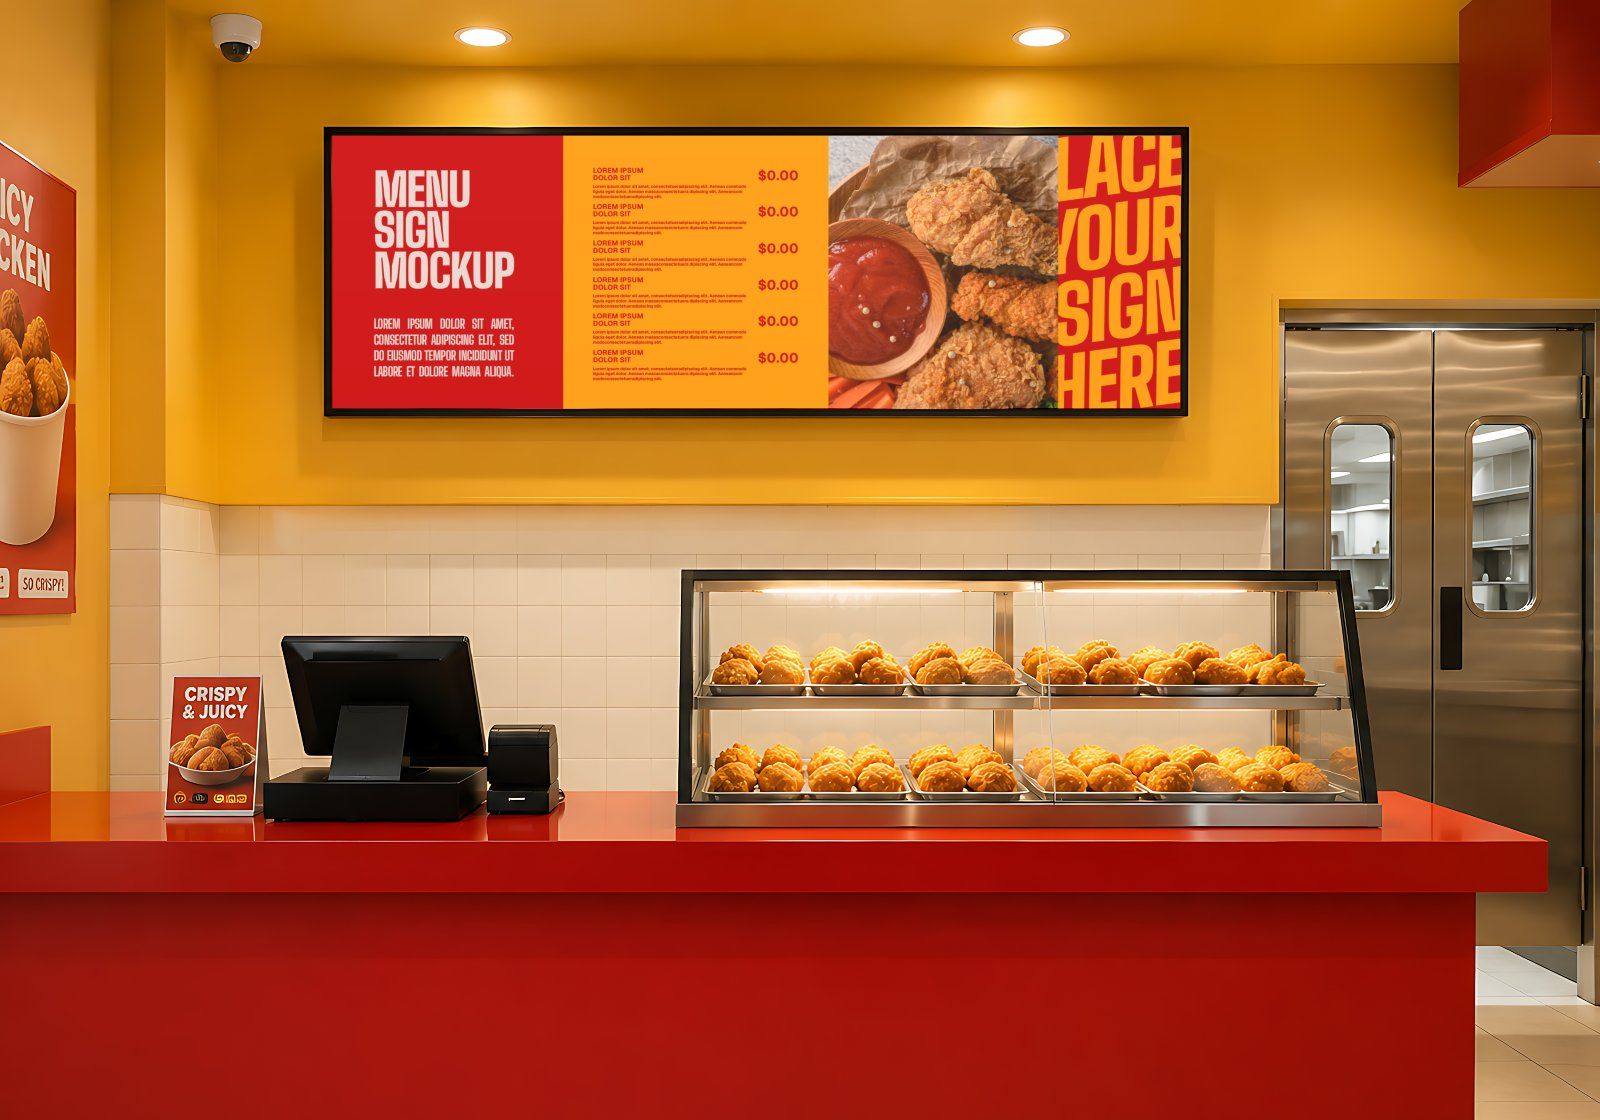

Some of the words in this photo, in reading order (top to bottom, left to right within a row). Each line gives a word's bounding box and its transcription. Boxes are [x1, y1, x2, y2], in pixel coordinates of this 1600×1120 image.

[1058, 135, 1181, 201] LACE
[759, 169, 798, 181] $0.00
[376, 170, 470, 208] MENU
[759, 205, 798, 218] $0.00
[375, 210, 449, 248] SIGN
[1058, 195, 1181, 275] YOUR
[758, 242, 798, 254] $0.00
[375, 251, 514, 289] MOCKUP
[758, 279, 798, 291] $0.00
[1058, 266, 1181, 347] SIGN
[374, 318, 400, 329] LOREM
[408, 318, 432, 329] IPSUM
[440, 318, 465, 329] DOLOR
[472, 318, 484, 329] SIT
[491, 318, 514, 330] AMET,
[759, 315, 798, 327] $0.00
[374, 334, 427, 345] CONSECTETUR
[431, 334, 474, 345] ADIPISCING
[478, 334, 495, 346] ELIT,
[500, 334, 514, 345] SED
[374, 350, 384, 361] DO
[387, 350, 422, 361] EIUSMOD
[424, 350, 456, 361] TEMPOR
[459, 350, 502, 361] INCIDIDUNT
[505, 350, 514, 361] UT
[759, 352, 798, 364] $0.00
[374, 366, 402, 377] LABORE
[407, 366, 415, 377] ET
[419, 366, 448, 377] DOLORE
[452, 366, 481, 377] MAGNA
[485, 366, 514, 378] ALIQUA.
[1058, 339, 1181, 408] HERE
[23, 577, 33, 590] SO
[184, 687, 247, 701] CRISPY
[183, 705, 194, 719] &
[199, 705, 248, 719] JUICY
